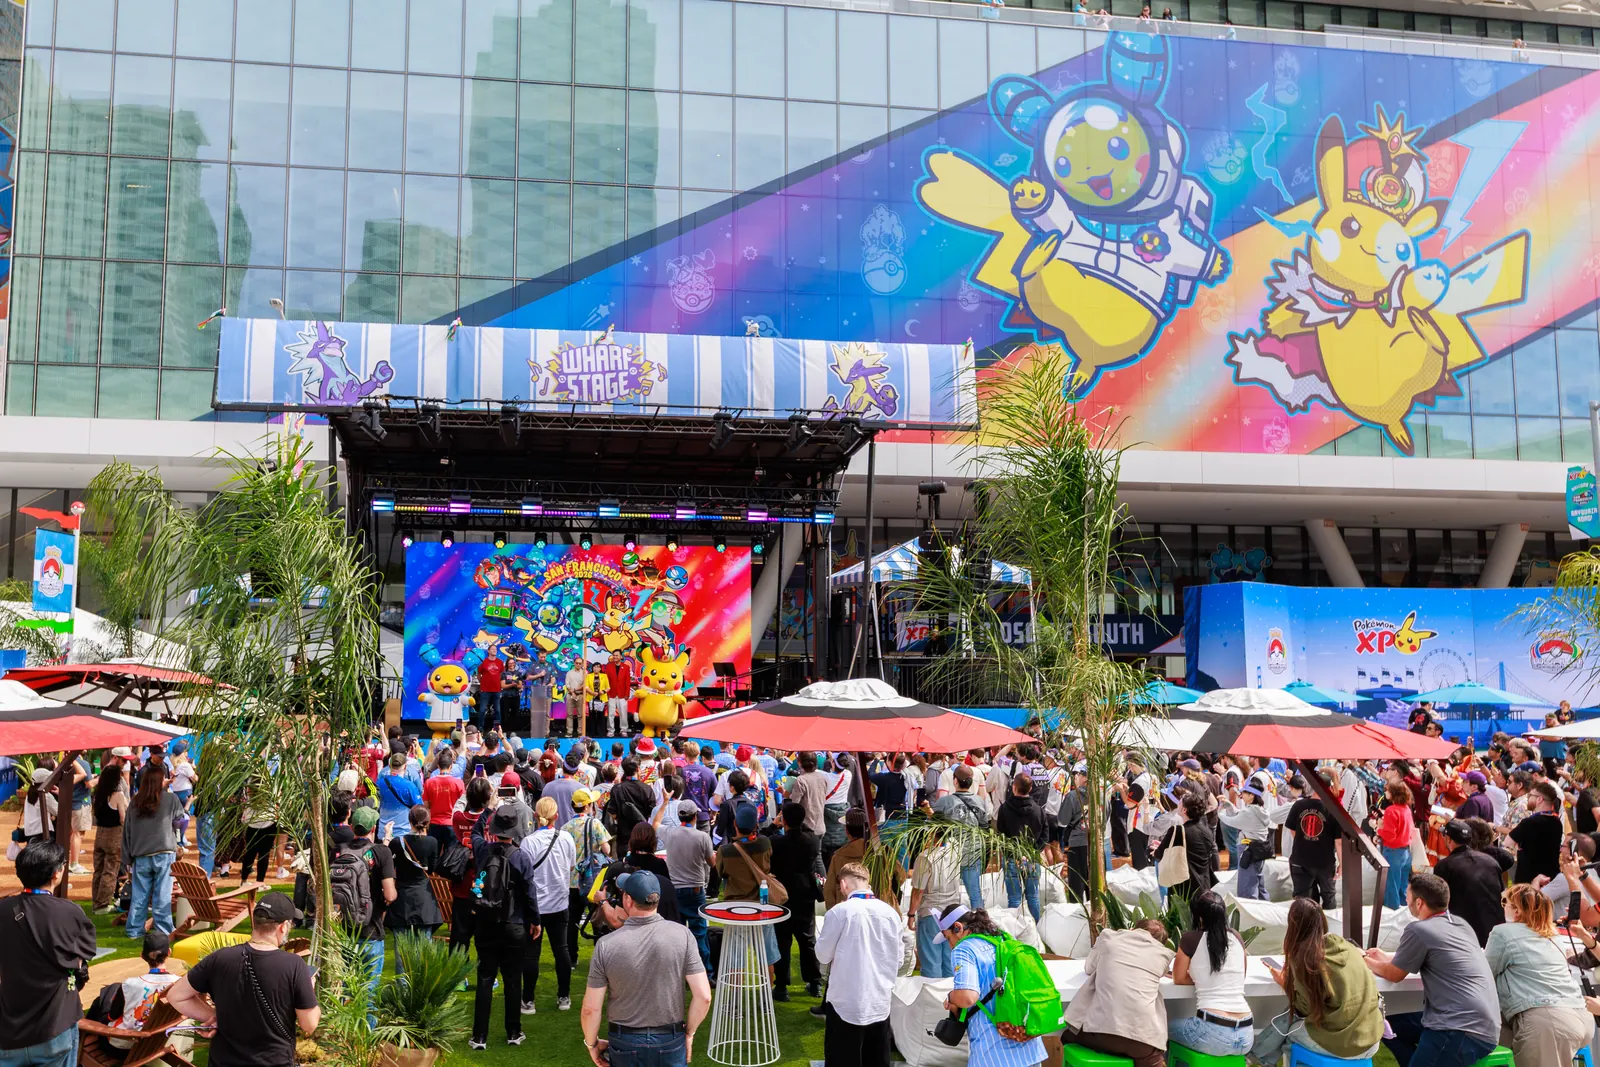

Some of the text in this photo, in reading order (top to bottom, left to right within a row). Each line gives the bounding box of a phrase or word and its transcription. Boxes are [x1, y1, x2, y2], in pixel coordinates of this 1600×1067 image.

[562, 345, 633, 373] WHARF
[567, 371, 630, 401] STAGE
[543, 560, 622, 582] SAN FRANCISCO
[574, 571, 593, 579] 2026
[905, 625, 930, 641] XP
[1083, 622, 1144, 645] OUTH
[1354, 620, 1396, 631] Pokémon
[1356, 631, 1396, 654] XP
